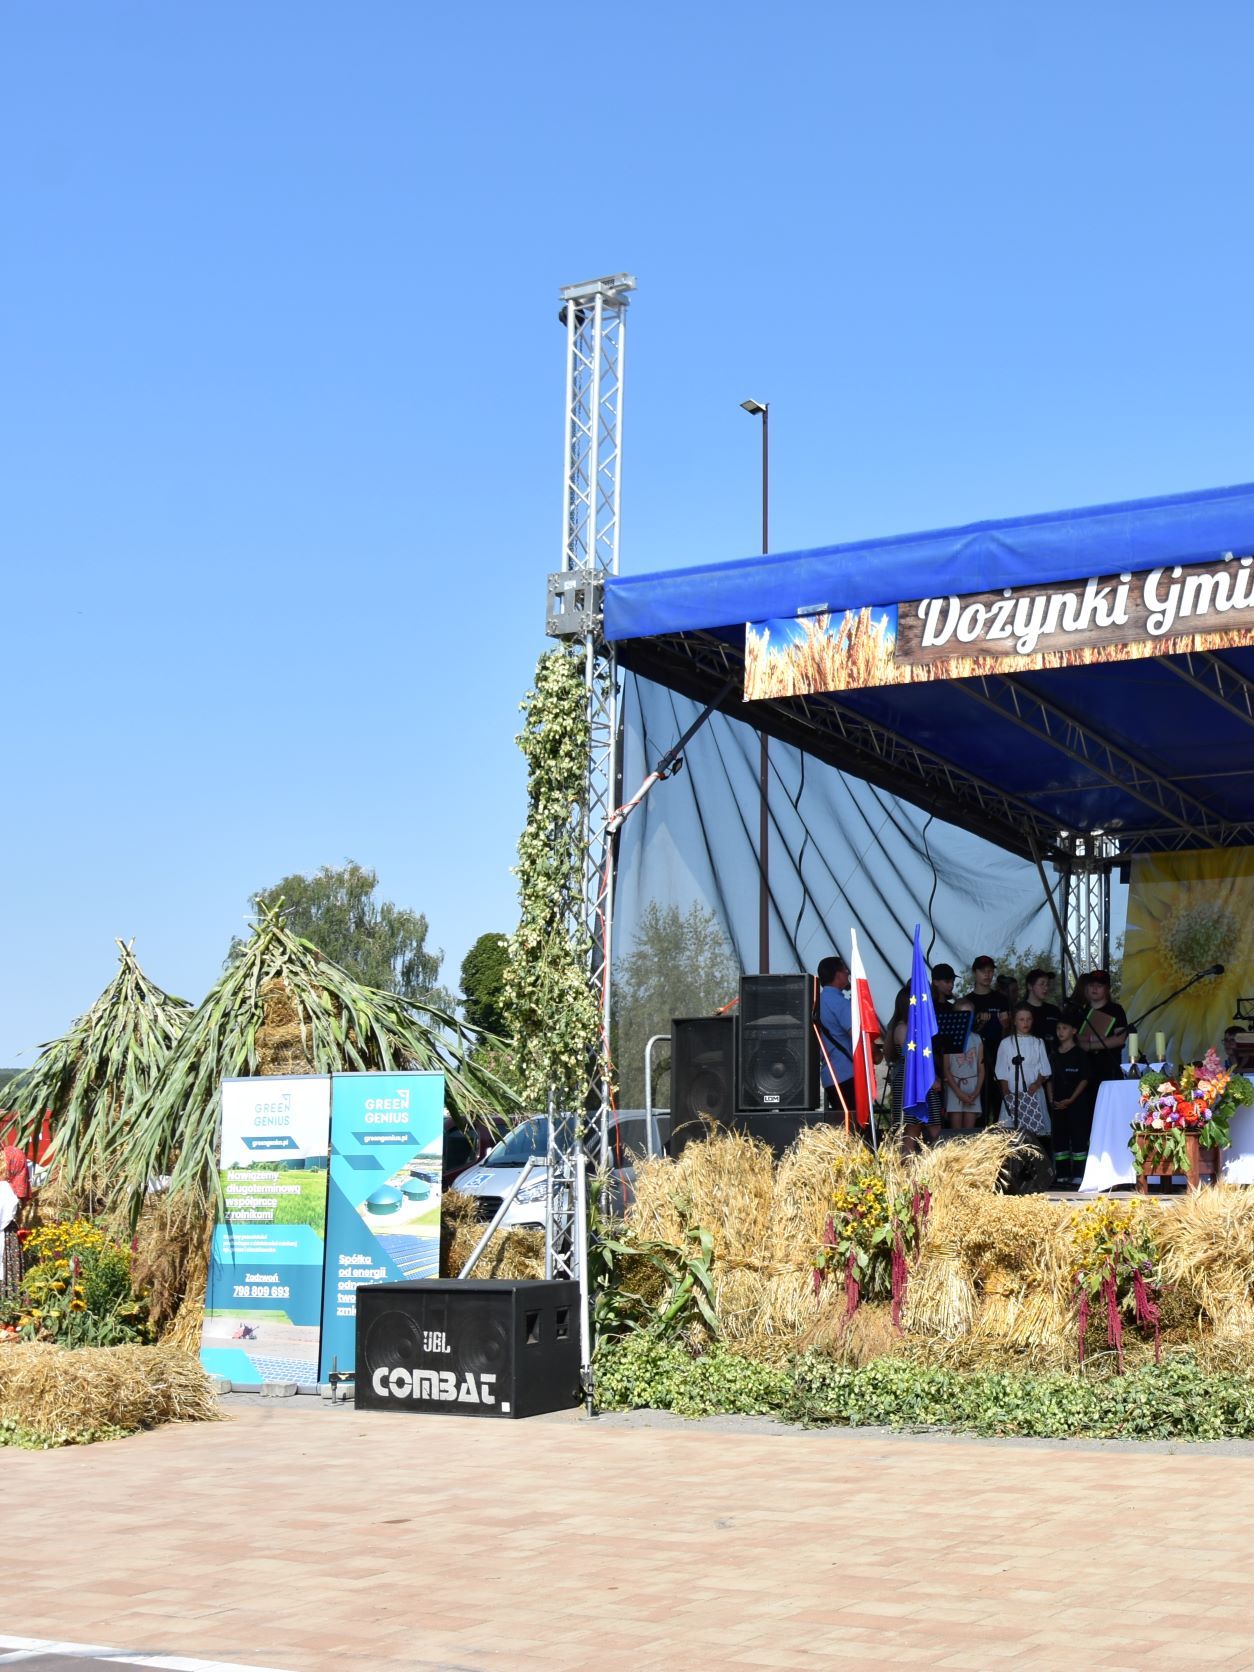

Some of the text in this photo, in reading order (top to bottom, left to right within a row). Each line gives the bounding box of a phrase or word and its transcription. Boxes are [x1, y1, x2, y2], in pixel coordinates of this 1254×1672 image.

[918, 573, 1131, 654] Dożynki
[255, 1099, 291, 1113] GREEN
[365, 1094, 410, 1110] GREEN
[254, 1116, 290, 1126] GENIUS
[364, 1112, 409, 1124] GENIUS
[231, 1209, 274, 1219] rolnikami
[339, 1253, 372, 1266] Spółka
[339, 1266, 386, 1279] od energii
[233, 1286, 290, 1297] 798 809 693
[423, 1331, 450, 1353] JBL
[372, 1367, 497, 1405] COMBAT
